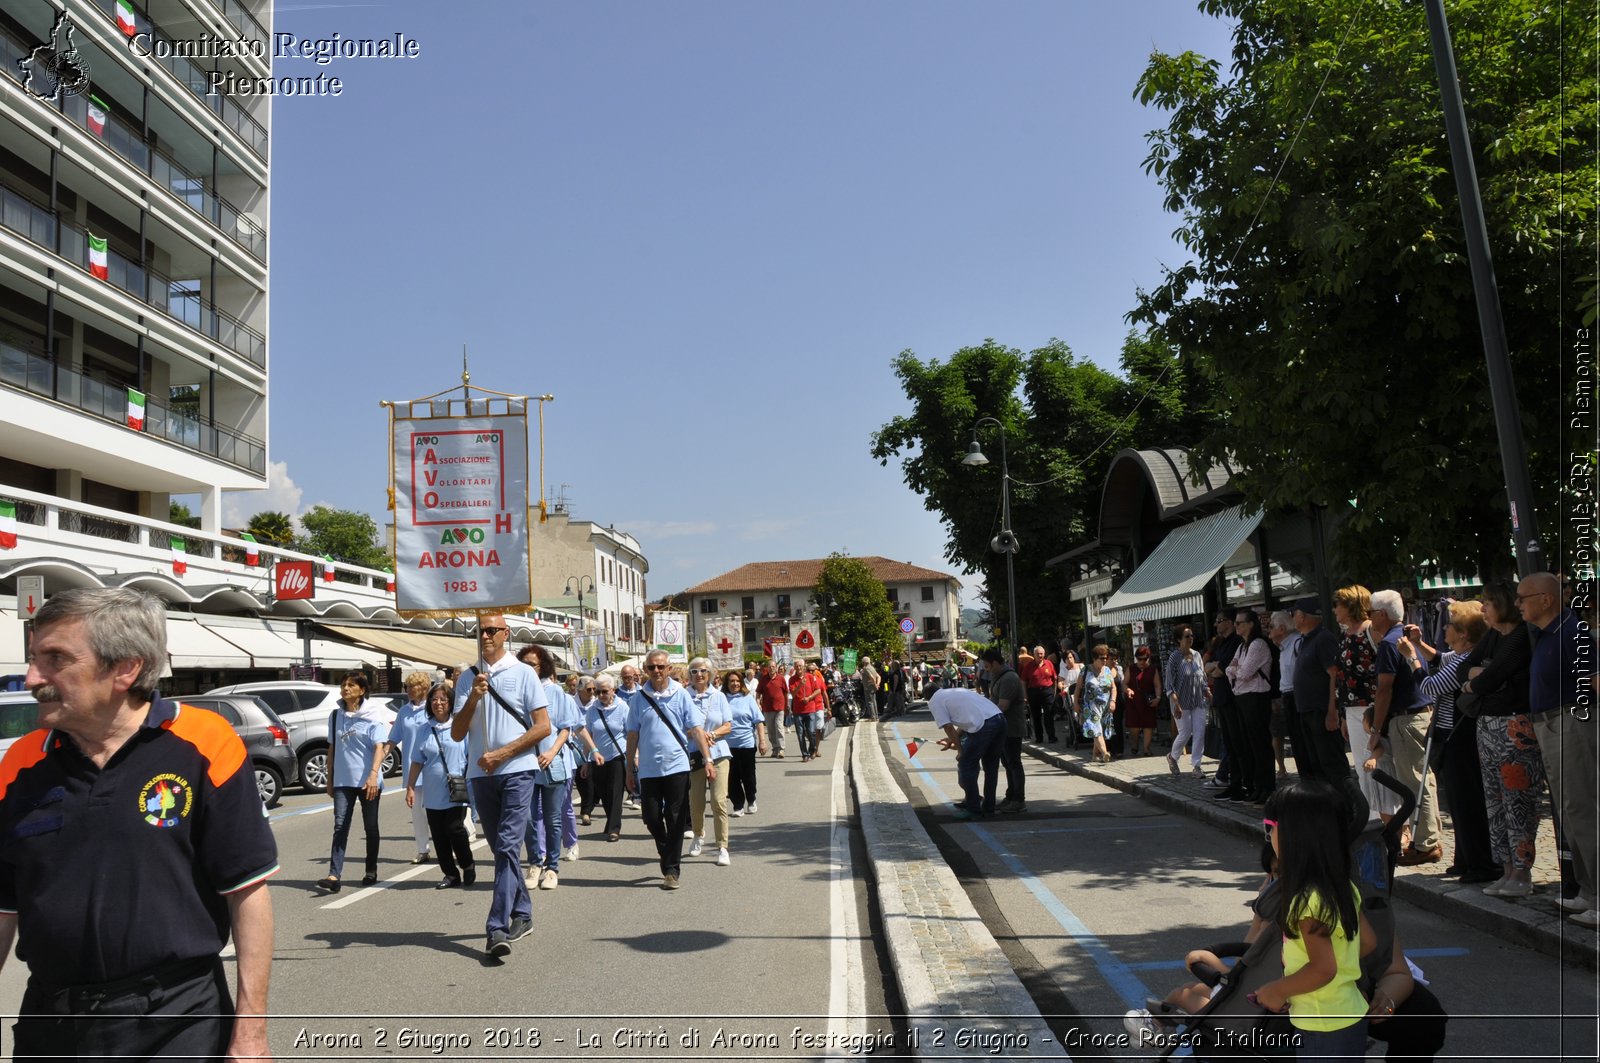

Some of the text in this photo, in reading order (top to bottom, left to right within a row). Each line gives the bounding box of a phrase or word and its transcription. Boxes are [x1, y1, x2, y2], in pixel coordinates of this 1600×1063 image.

[495, 513, 512, 534] H
[418, 549, 501, 569] ARONA
[280, 568, 309, 595] illy
[443, 580, 478, 593] 1983
[142, 773, 176, 790] VOLONTARI
[139, 791, 148, 812] CORPO
